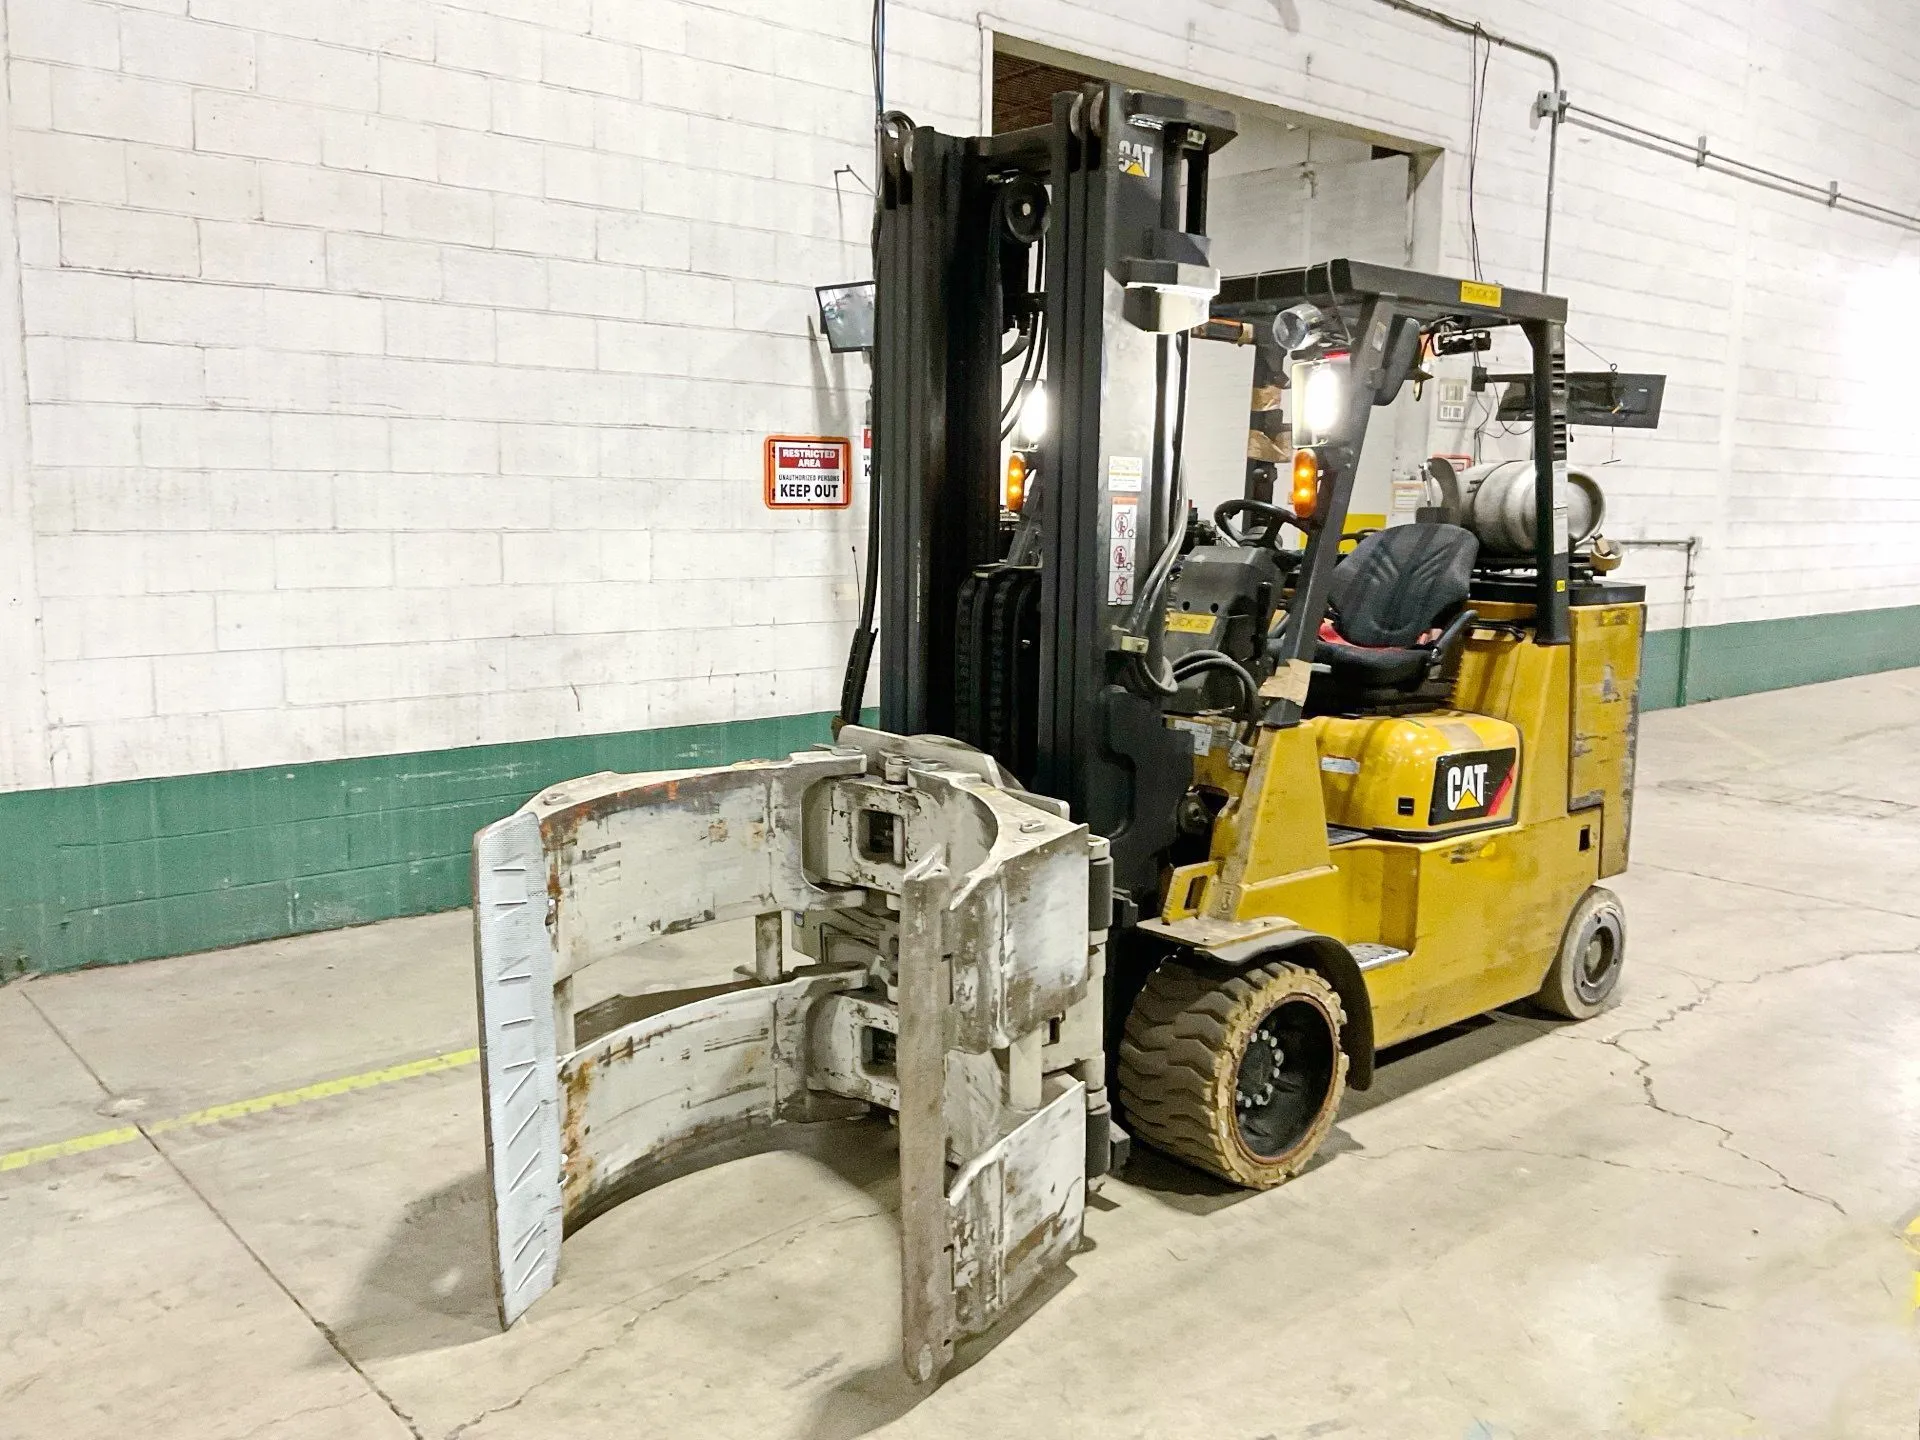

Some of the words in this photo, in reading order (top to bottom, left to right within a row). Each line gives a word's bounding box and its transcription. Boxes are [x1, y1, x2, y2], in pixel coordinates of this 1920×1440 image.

[1118, 140, 1153, 178] CAT
[782, 448, 836, 459] RESTRICTED
[797, 459, 821, 468] AREA
[817, 474, 840, 482] PERSONS
[780, 484, 811, 498] KEEP
[814, 484, 839, 498] OUT
[1446, 763, 1488, 811] CAT
